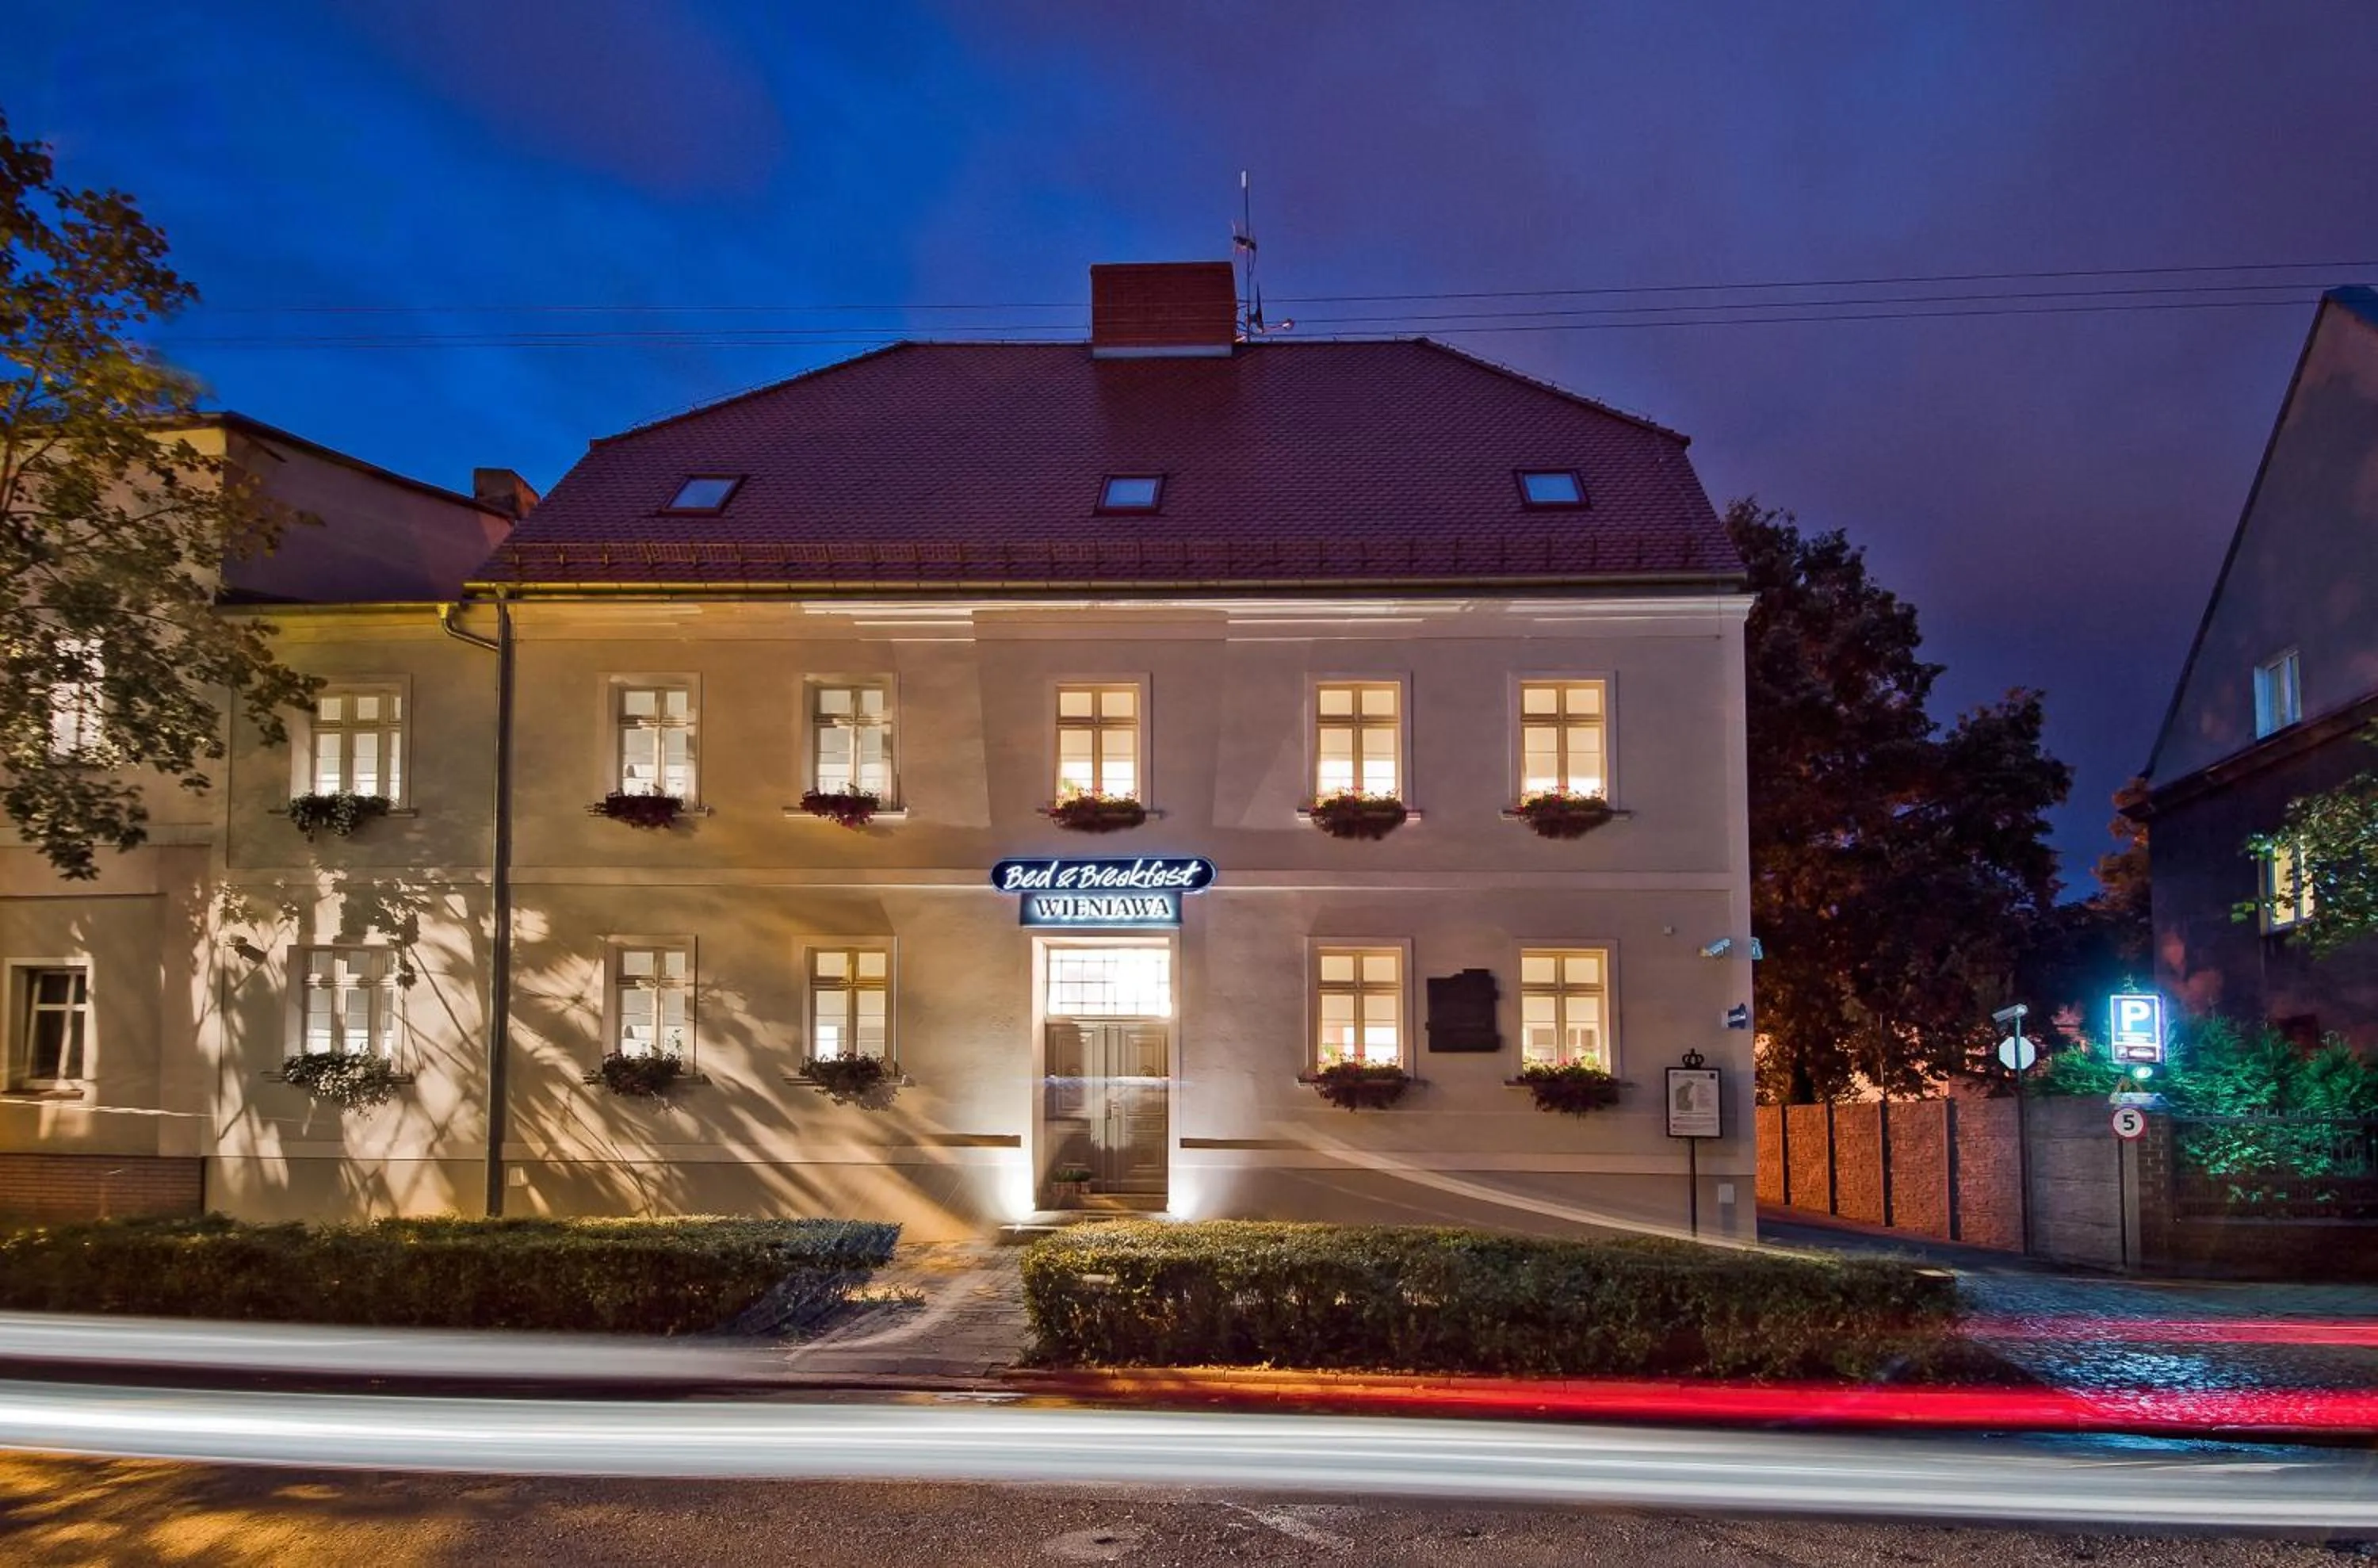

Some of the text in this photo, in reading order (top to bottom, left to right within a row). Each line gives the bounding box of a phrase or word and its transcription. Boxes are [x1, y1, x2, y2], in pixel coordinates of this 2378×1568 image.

[1004, 859, 1201, 889] Bed & Breakfast
[1035, 897, 1169, 916] WIENIAWA
[2120, 1000, 2151, 1031] P
[2123, 1114, 2135, 1131] 5
